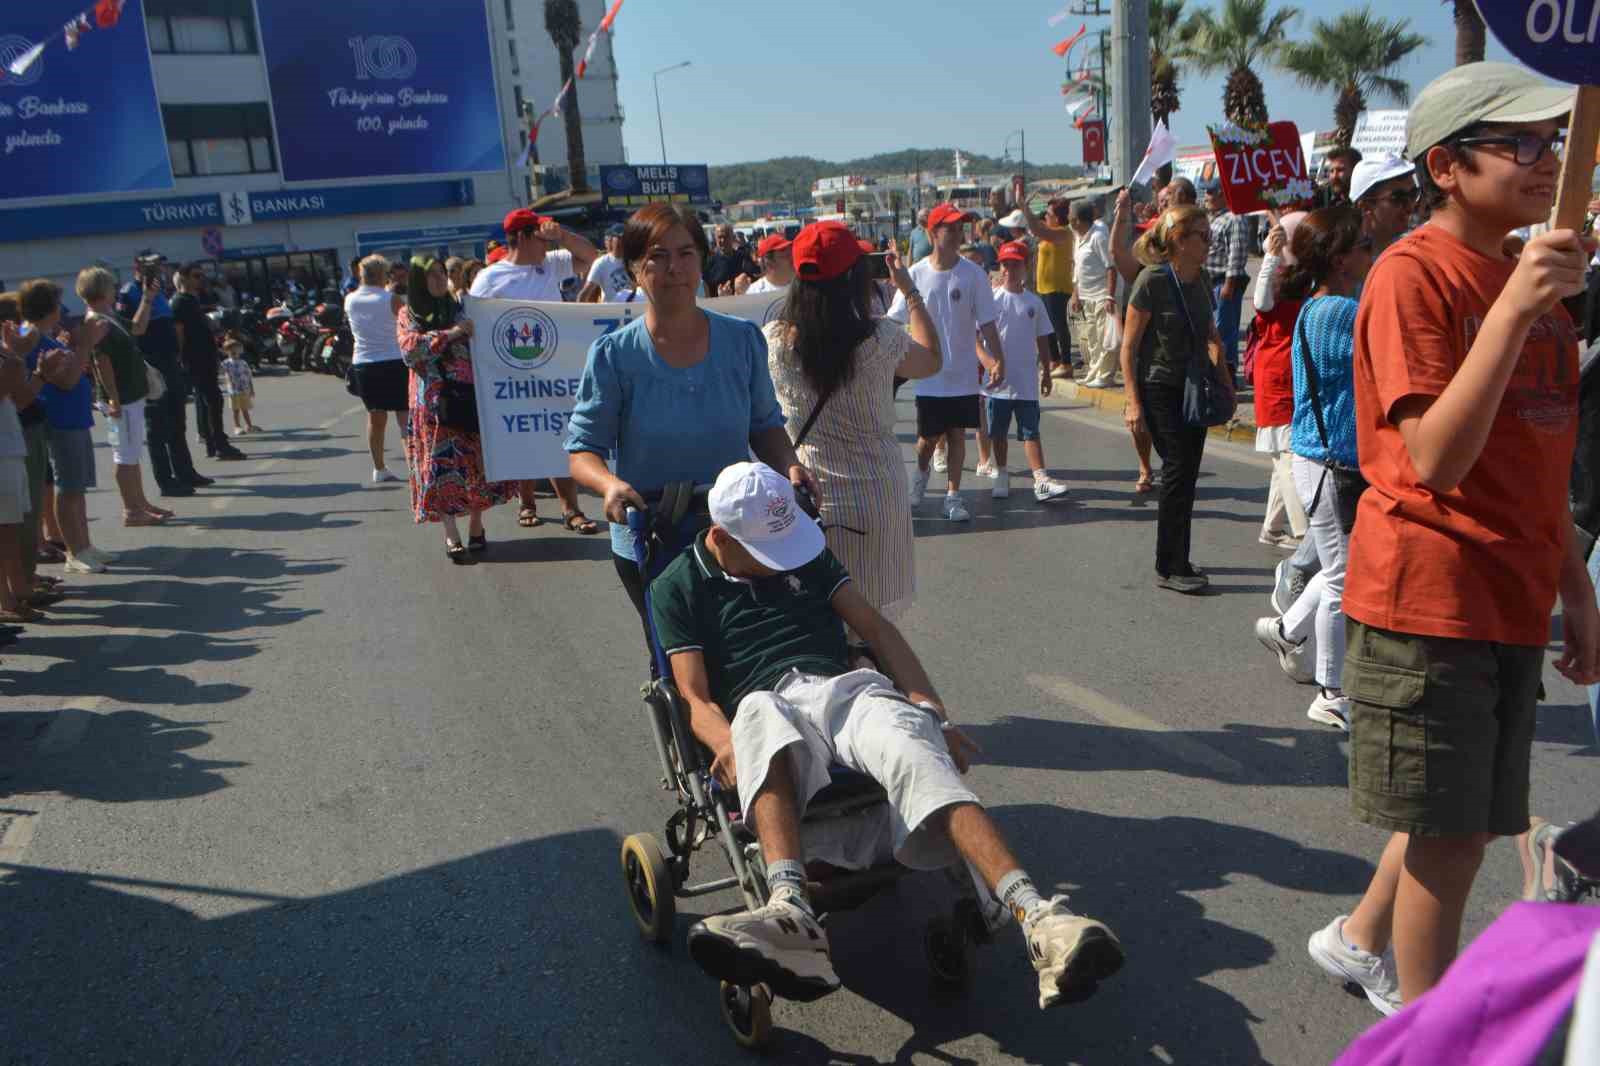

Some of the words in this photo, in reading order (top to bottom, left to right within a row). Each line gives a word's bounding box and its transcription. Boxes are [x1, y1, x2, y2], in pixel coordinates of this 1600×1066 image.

[16, 95, 89, 119] Bankası
[397, 86, 448, 108] Bankası
[387, 114, 430, 136] yılında
[5, 128, 63, 153] yılında
[1224, 145, 1302, 187] ZİÇEV
[142, 202, 218, 223] TÜRKİYE
[252, 195, 326, 213] BANKASI
